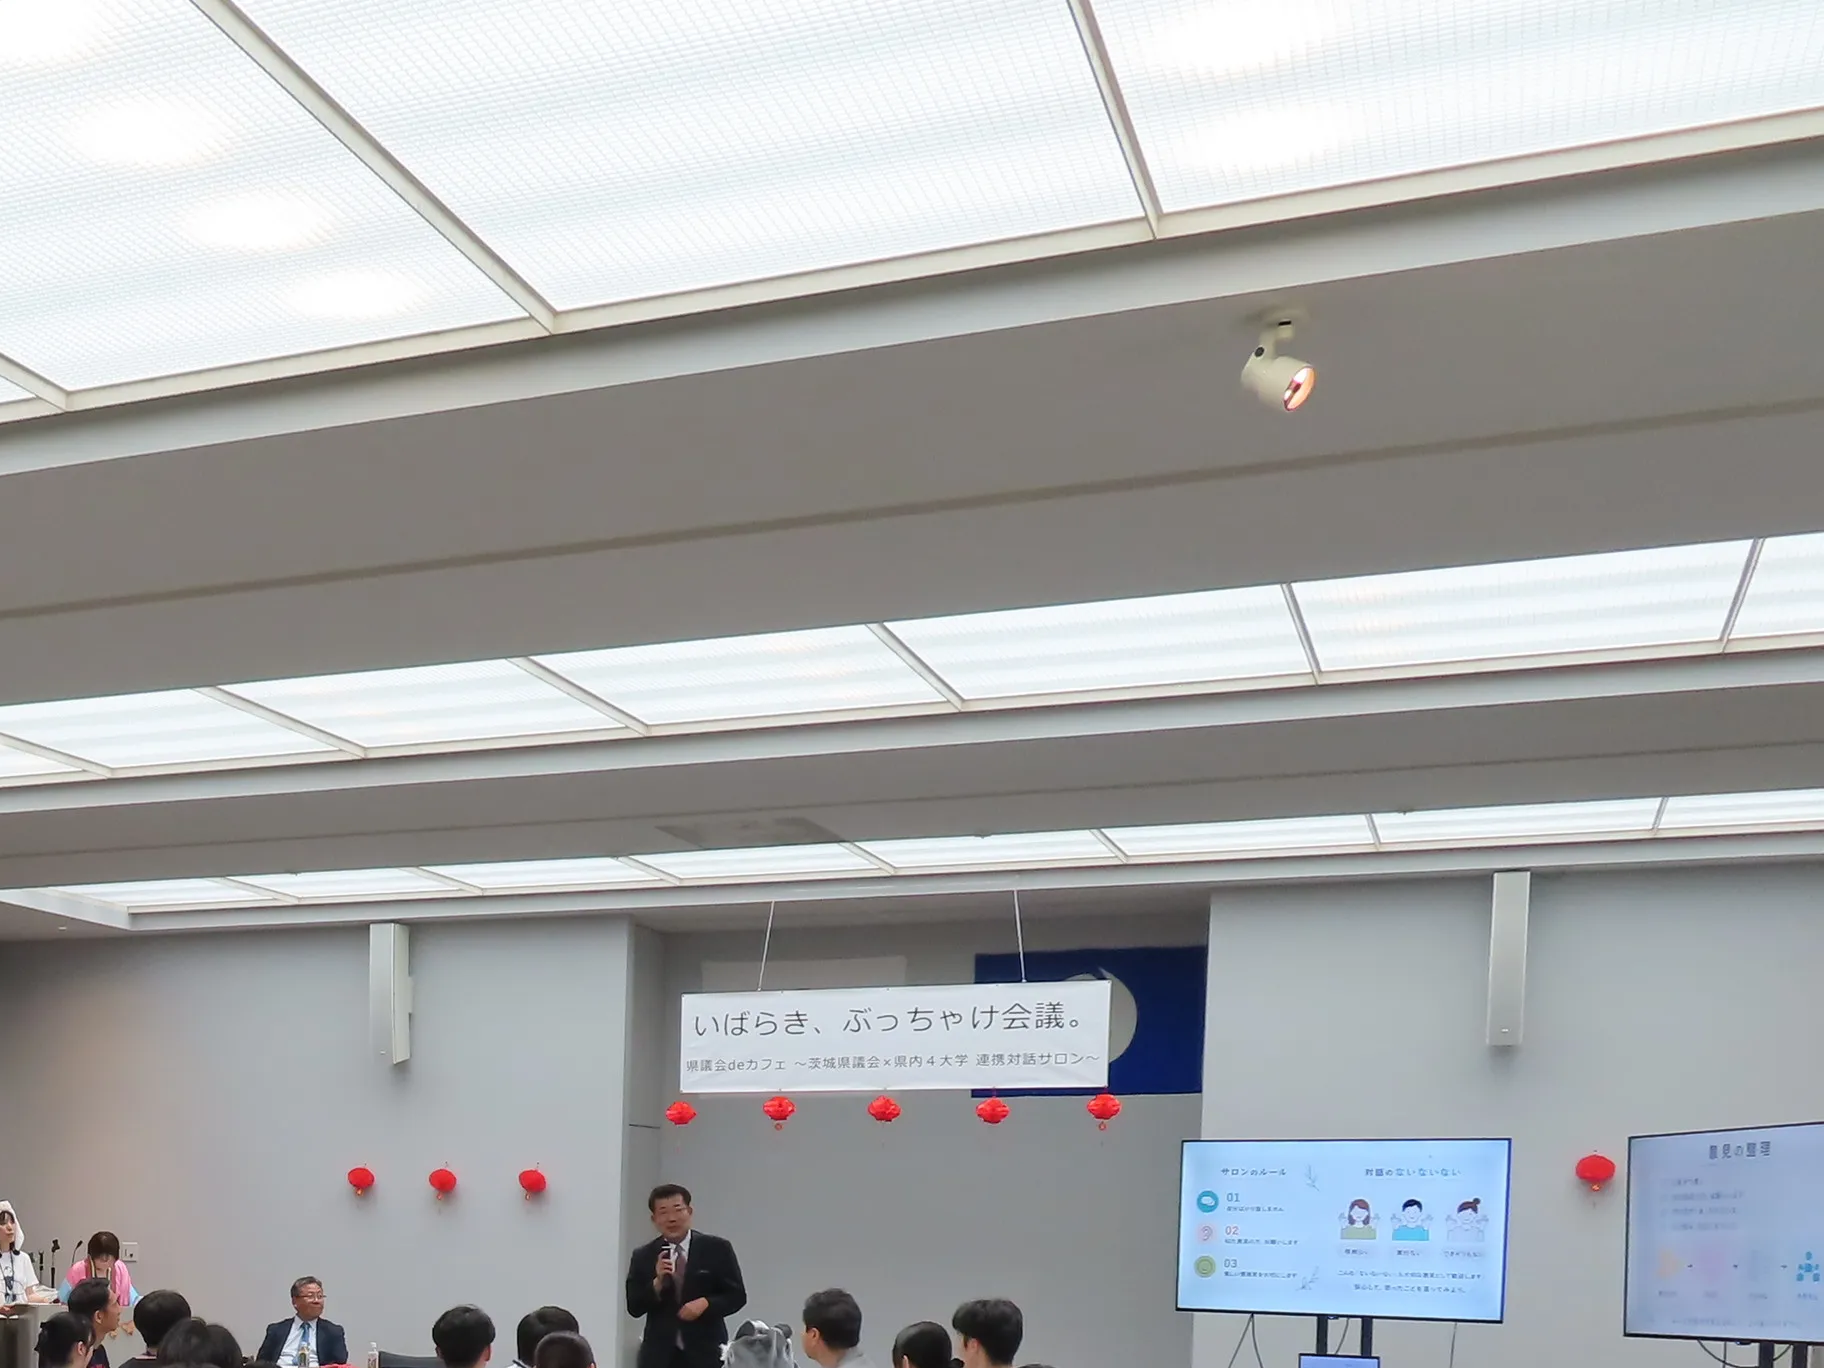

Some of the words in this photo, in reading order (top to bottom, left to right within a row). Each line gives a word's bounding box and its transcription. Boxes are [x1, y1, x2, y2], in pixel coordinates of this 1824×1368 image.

[694, 1001, 1080, 1037] いばらき、ぶっちゃけ会議。
[686, 1058, 786, 1072] 県議会deカフェ
[1221, 1168, 1287, 1176] サロンのルール
[1226, 1193, 1240, 1203] 01
[1225, 1226, 1239, 1236] 02
[1223, 1259, 1238, 1269] 03
